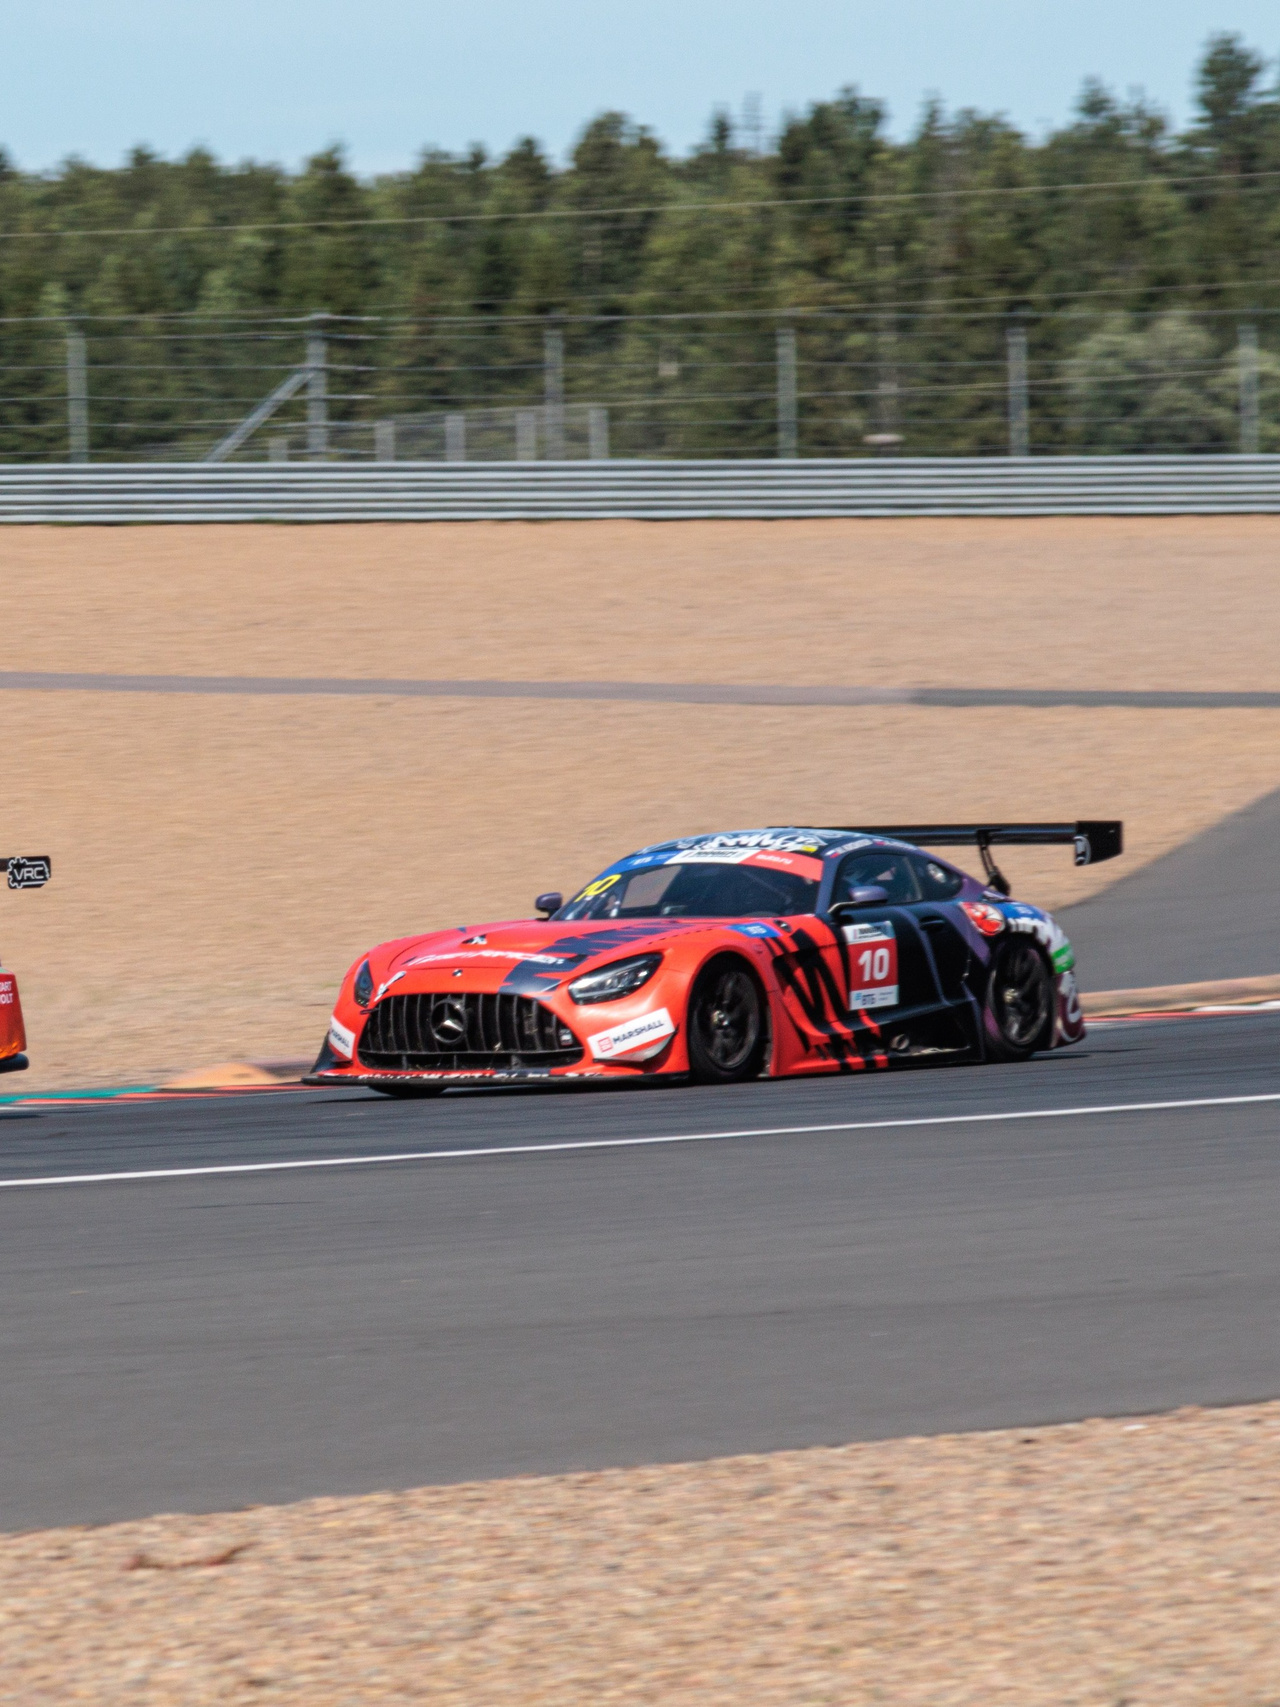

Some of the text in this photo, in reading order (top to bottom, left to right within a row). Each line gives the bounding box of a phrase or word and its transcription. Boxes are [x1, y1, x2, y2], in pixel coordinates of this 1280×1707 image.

[13, 866, 45, 881] VRC
[858, 948, 890, 982] 10
[612, 1019, 665, 1045] MARSHALL
